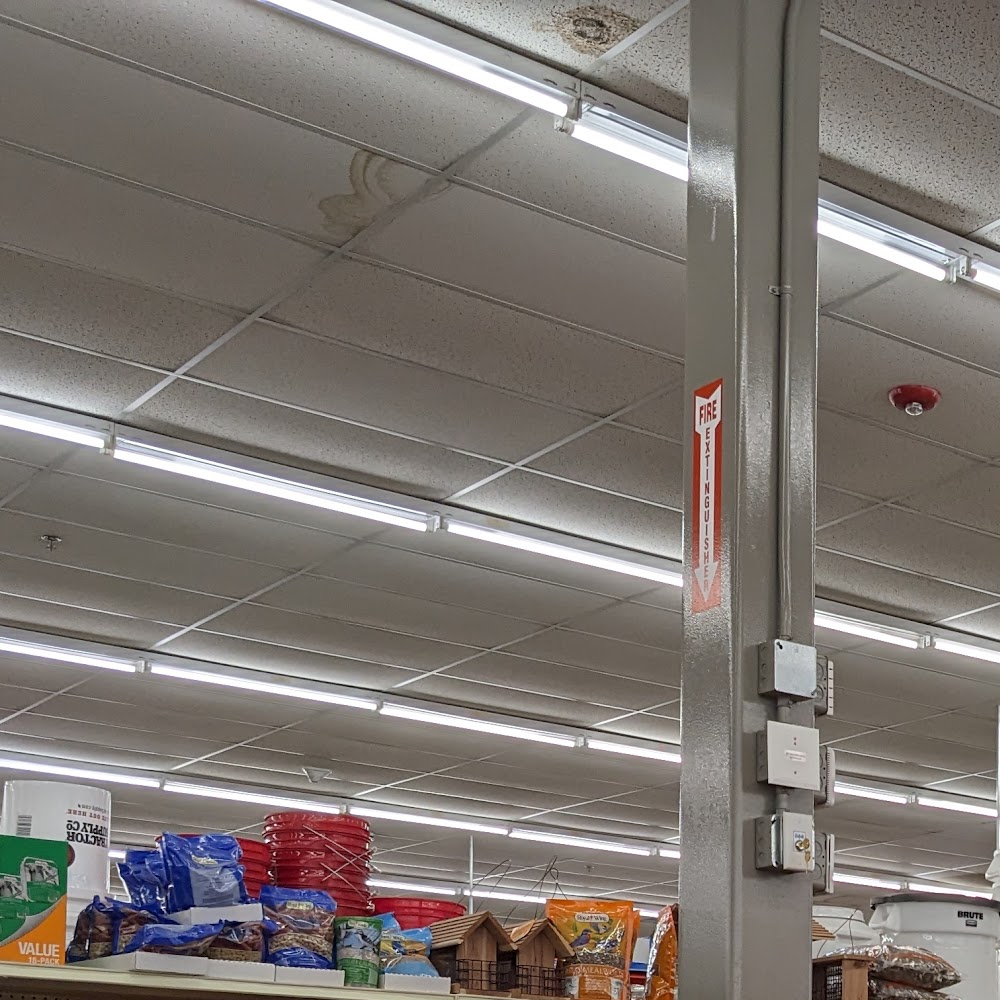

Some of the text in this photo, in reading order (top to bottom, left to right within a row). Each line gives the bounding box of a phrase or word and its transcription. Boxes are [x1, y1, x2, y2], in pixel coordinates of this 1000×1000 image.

[699, 405, 718, 426] FIRE
[702, 427, 713, 594] EXTINGUISHER
[957, 910, 984, 921] BRUTE
[18, 941, 60, 957] VALUE
